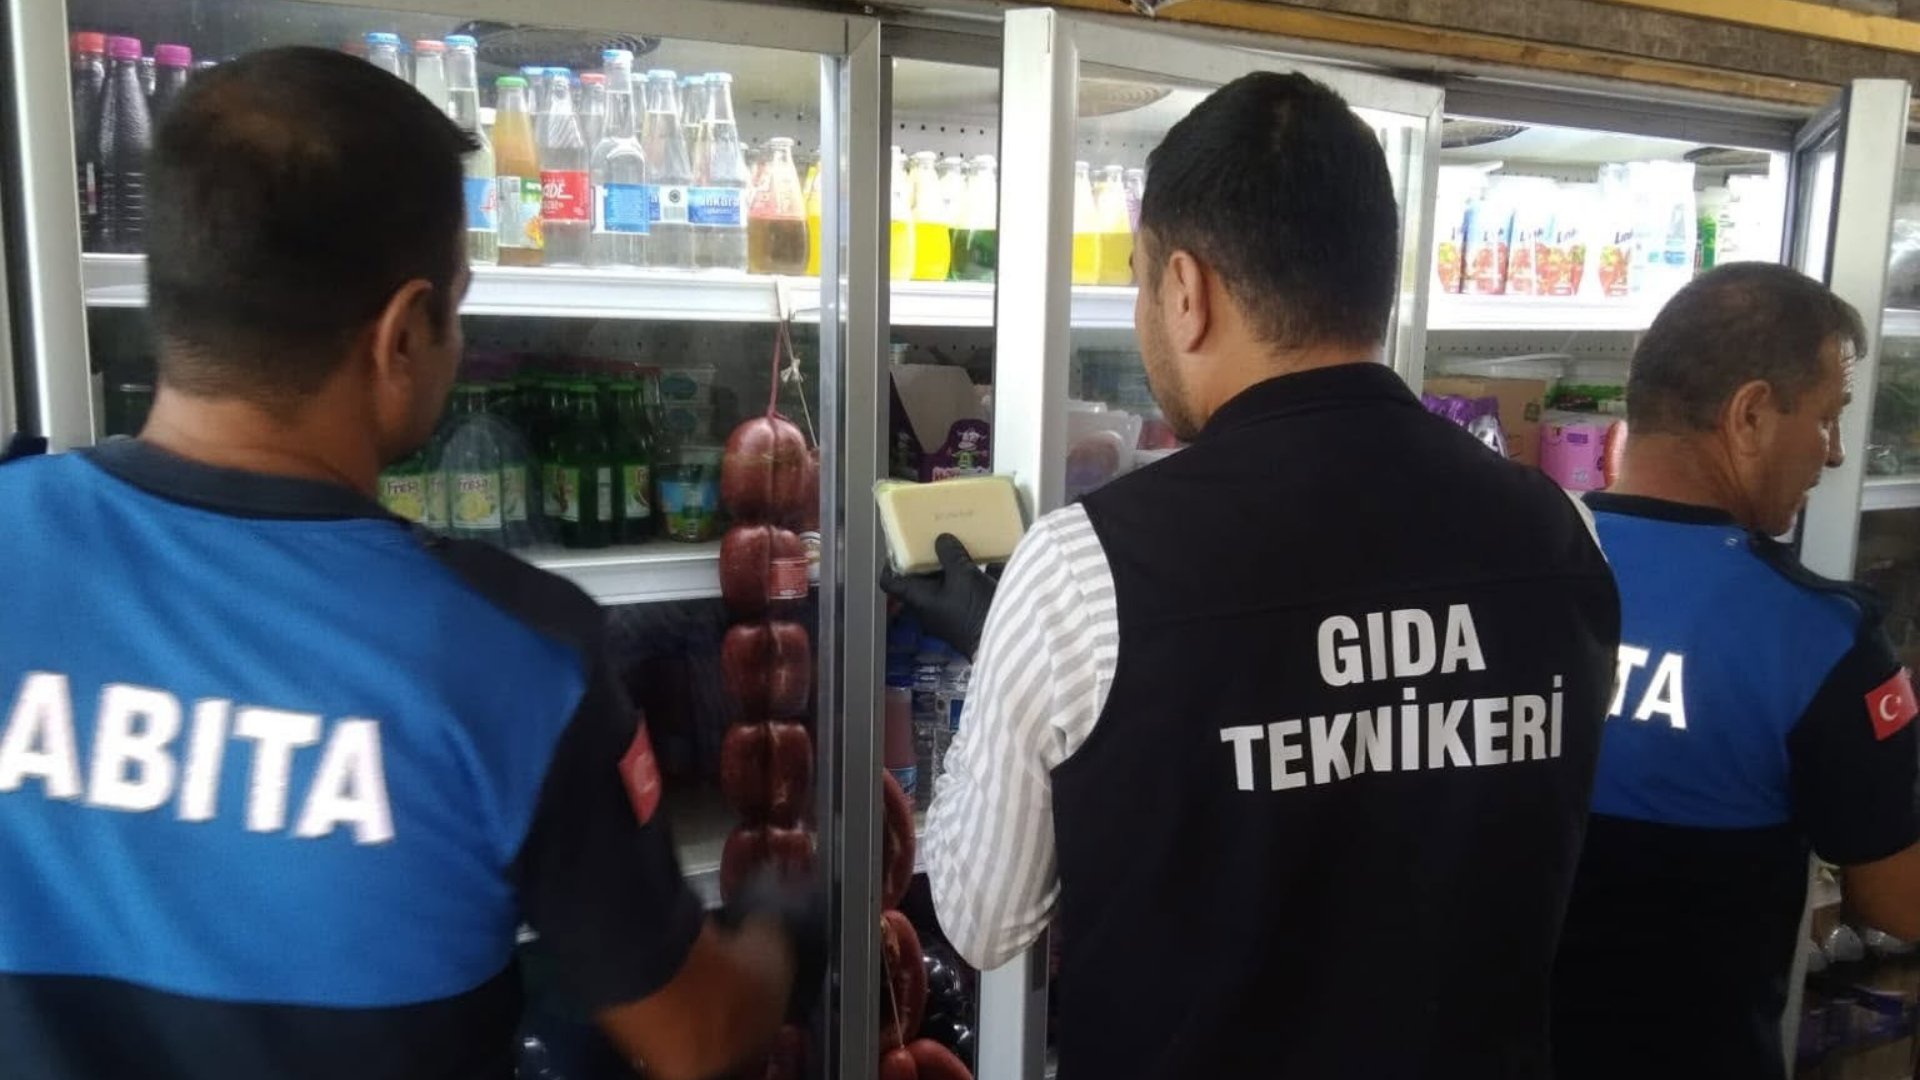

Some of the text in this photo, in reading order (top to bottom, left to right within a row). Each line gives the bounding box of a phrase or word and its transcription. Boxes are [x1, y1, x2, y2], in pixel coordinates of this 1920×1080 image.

[1316, 603, 1487, 688] GIDA
[0, 671, 394, 844] ABITA
[1219, 674, 1564, 791] TEKNİKERİ
